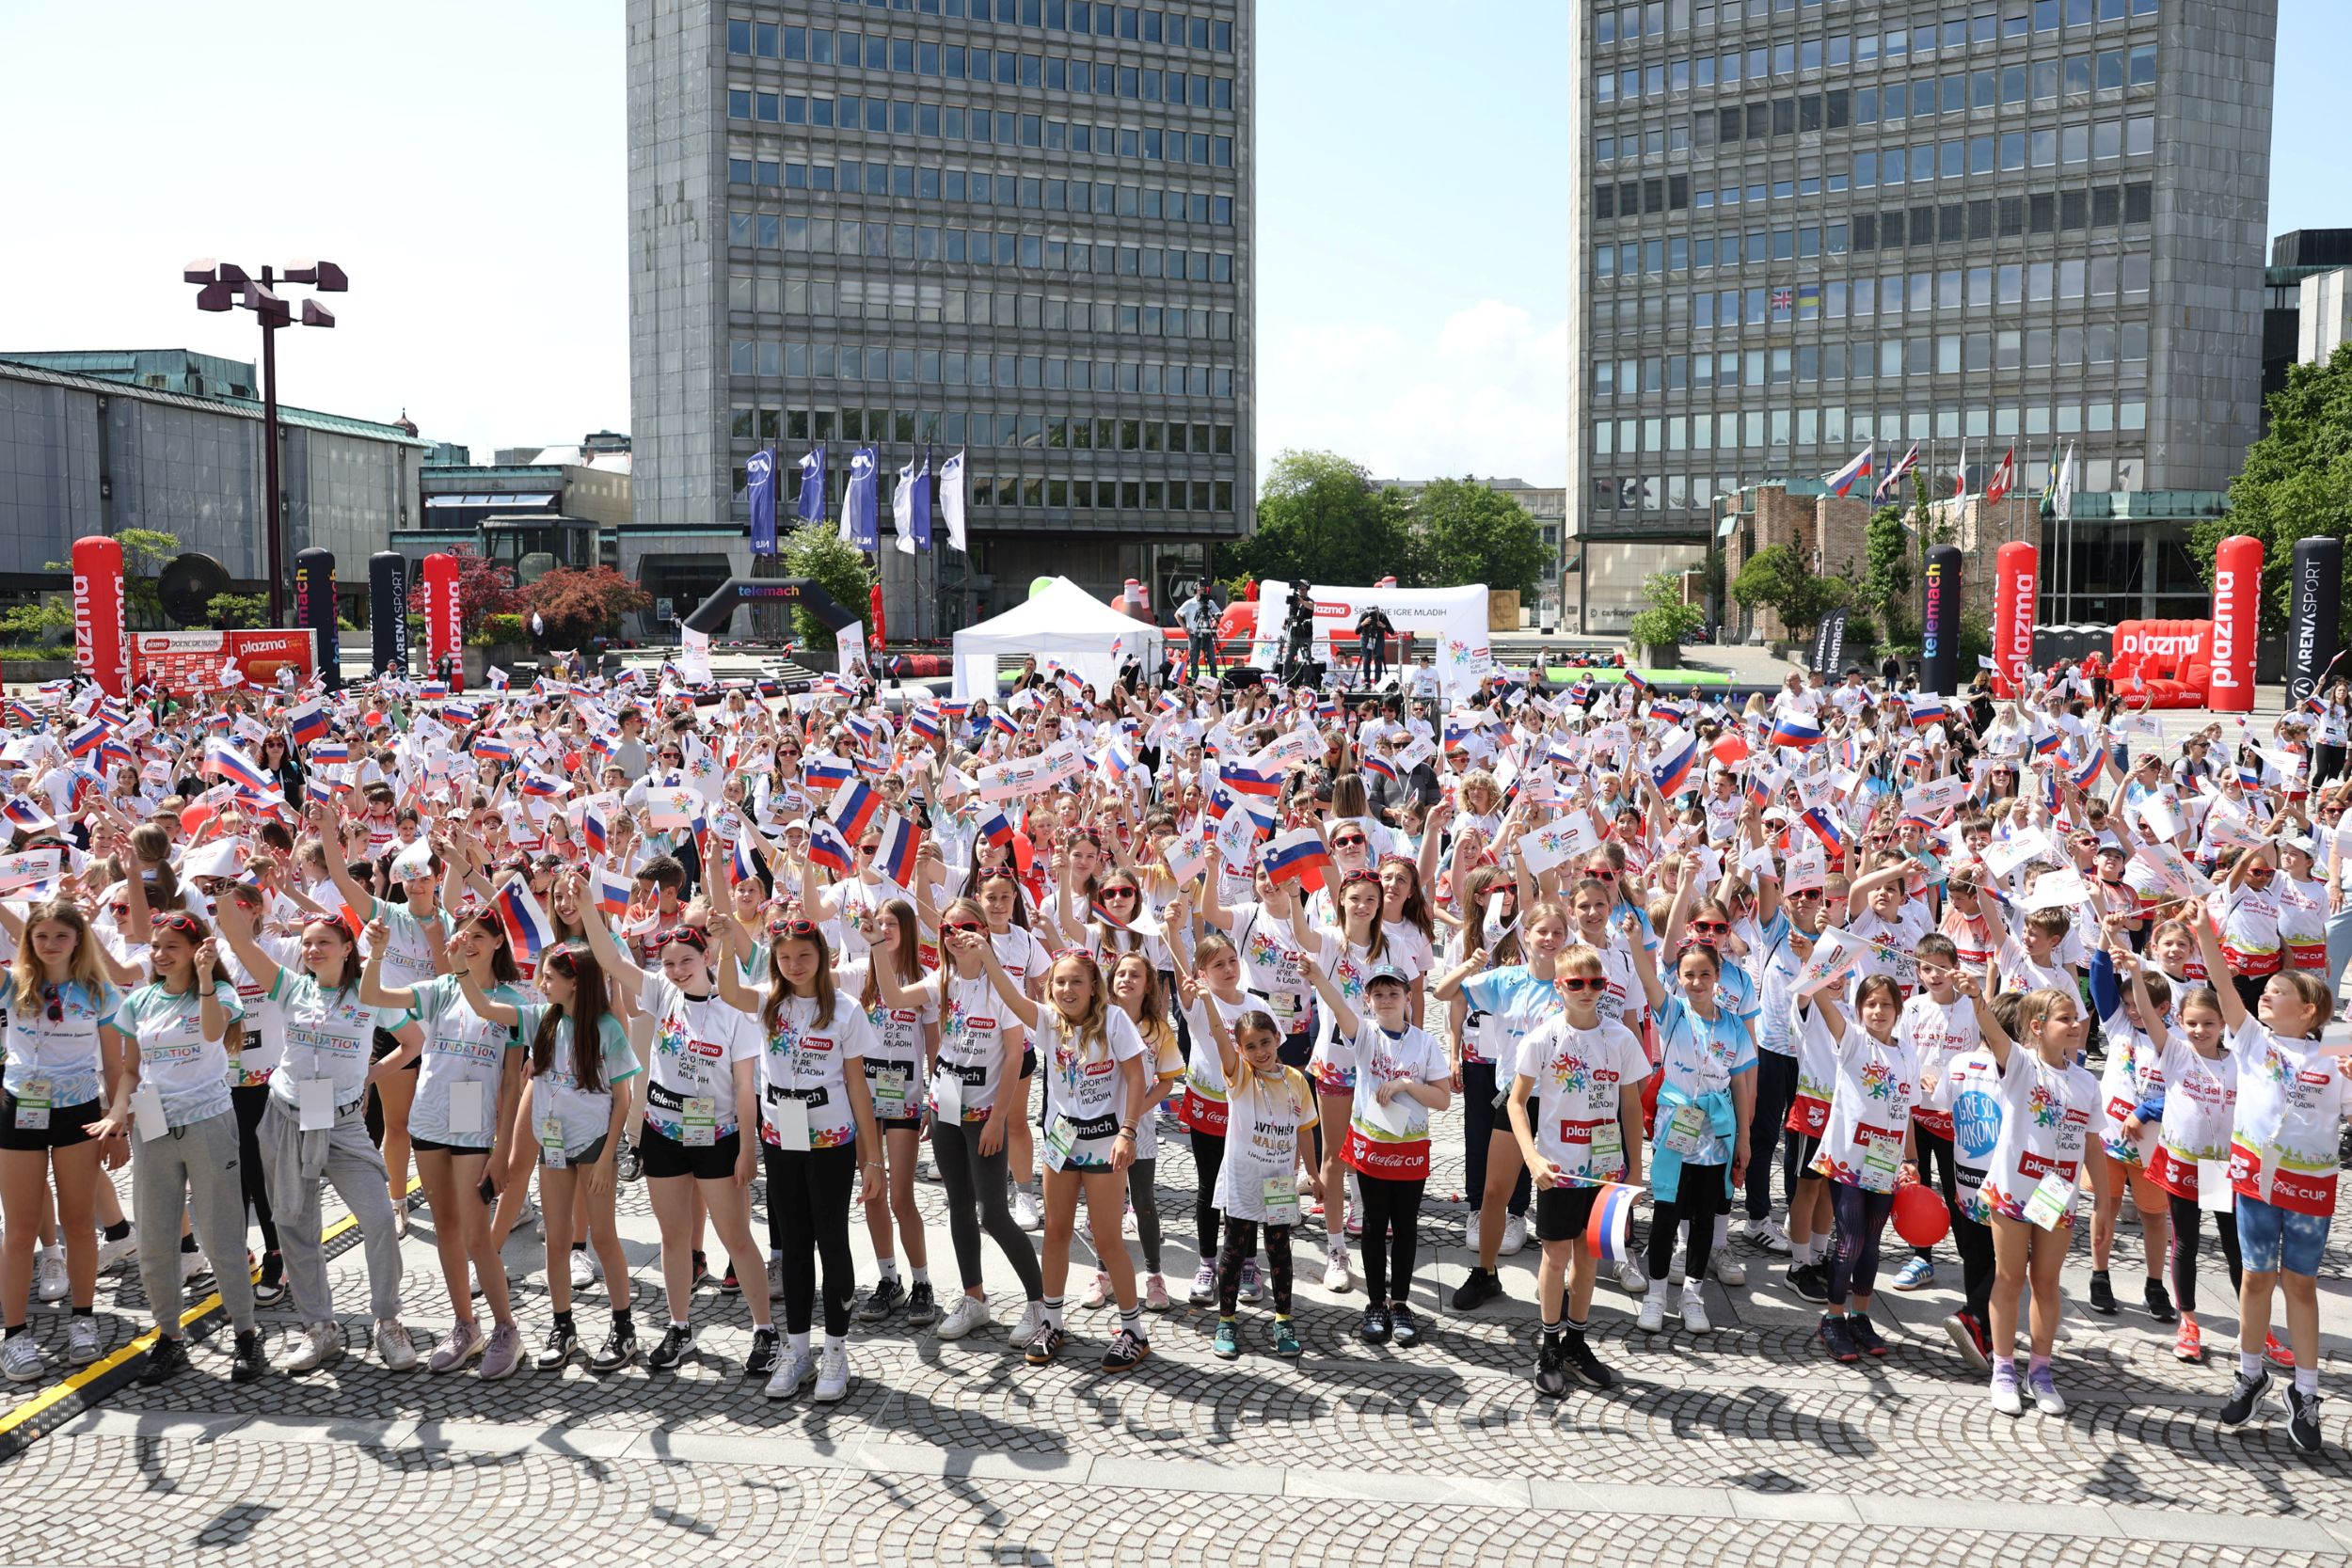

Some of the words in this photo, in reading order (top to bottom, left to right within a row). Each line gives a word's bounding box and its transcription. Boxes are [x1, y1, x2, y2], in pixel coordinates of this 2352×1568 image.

[738, 585, 800, 597] telemach
[1313, 604, 1346, 615] lazma
[1413, 609, 1447, 617] MLADIH
[1923, 563, 1942, 658] telemach
[73, 575, 95, 675] lazma
[448, 580, 465, 674] plazma
[2008, 574, 2034, 679] plazma
[2211, 571, 2238, 688] plazma
[239, 638, 287, 657] plazma
[1827, 616, 1844, 673] telemach
[2122, 629, 2200, 656] plazma
[1945, 1032, 1963, 1044] igre
[649, 1087, 684, 1112] telema
[2204, 1085, 2220, 1096] del
[1565, 1125, 1592, 1138] plaz
[1405, 1155, 1424, 1167] CUP
[2298, 1188, 2328, 1201] CUP
